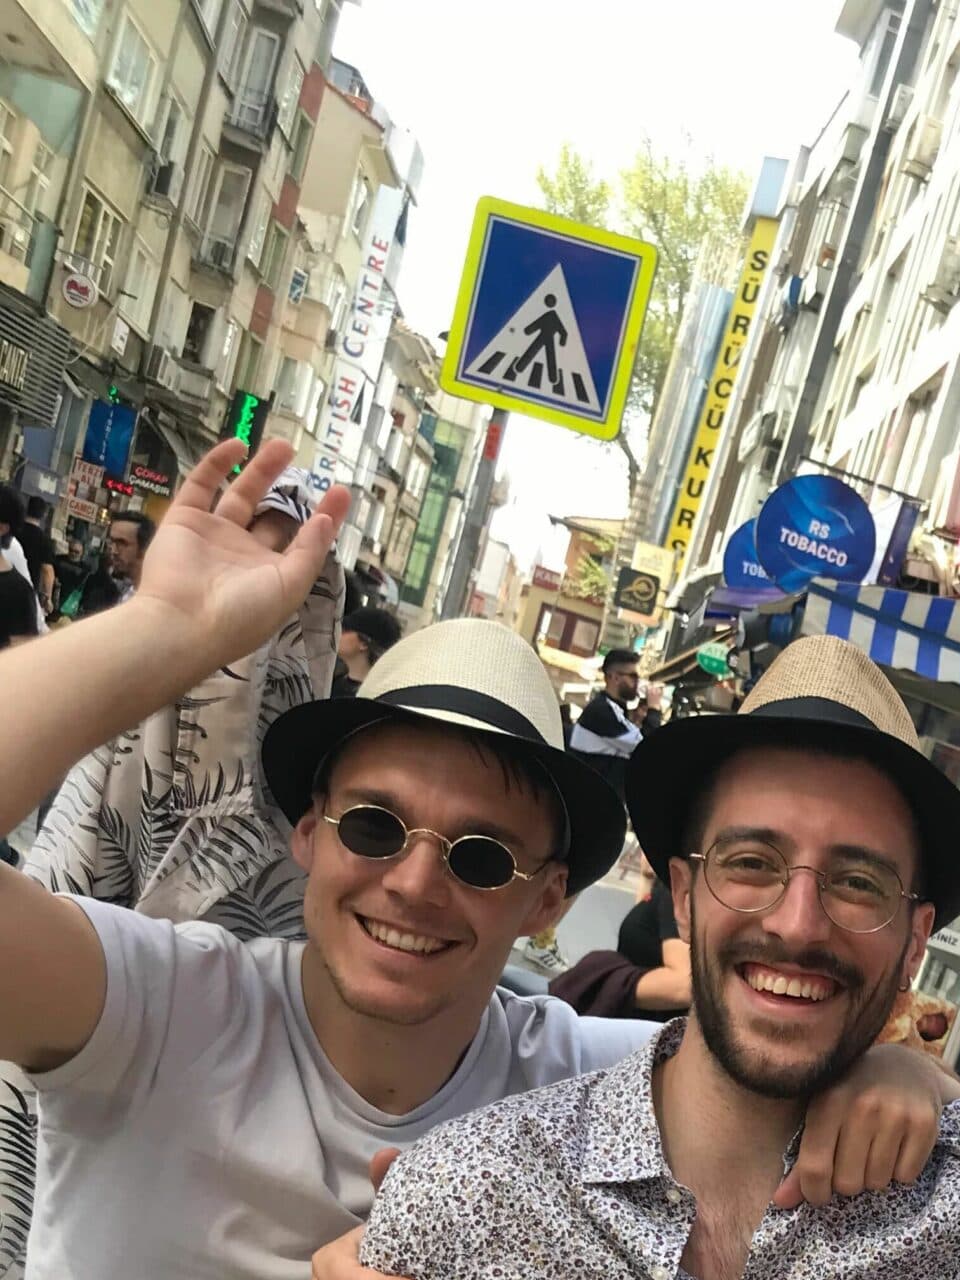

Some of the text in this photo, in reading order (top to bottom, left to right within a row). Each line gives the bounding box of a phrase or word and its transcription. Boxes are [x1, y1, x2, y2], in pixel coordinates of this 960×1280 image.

[706, 250, 768, 430] SÜRÜCÜ
[313, 235, 389, 491] BRITISH CENTRE
[779, 527, 849, 568] TOBACCO
[808, 519, 831, 539] RS
[742, 561, 770, 580] TOB
